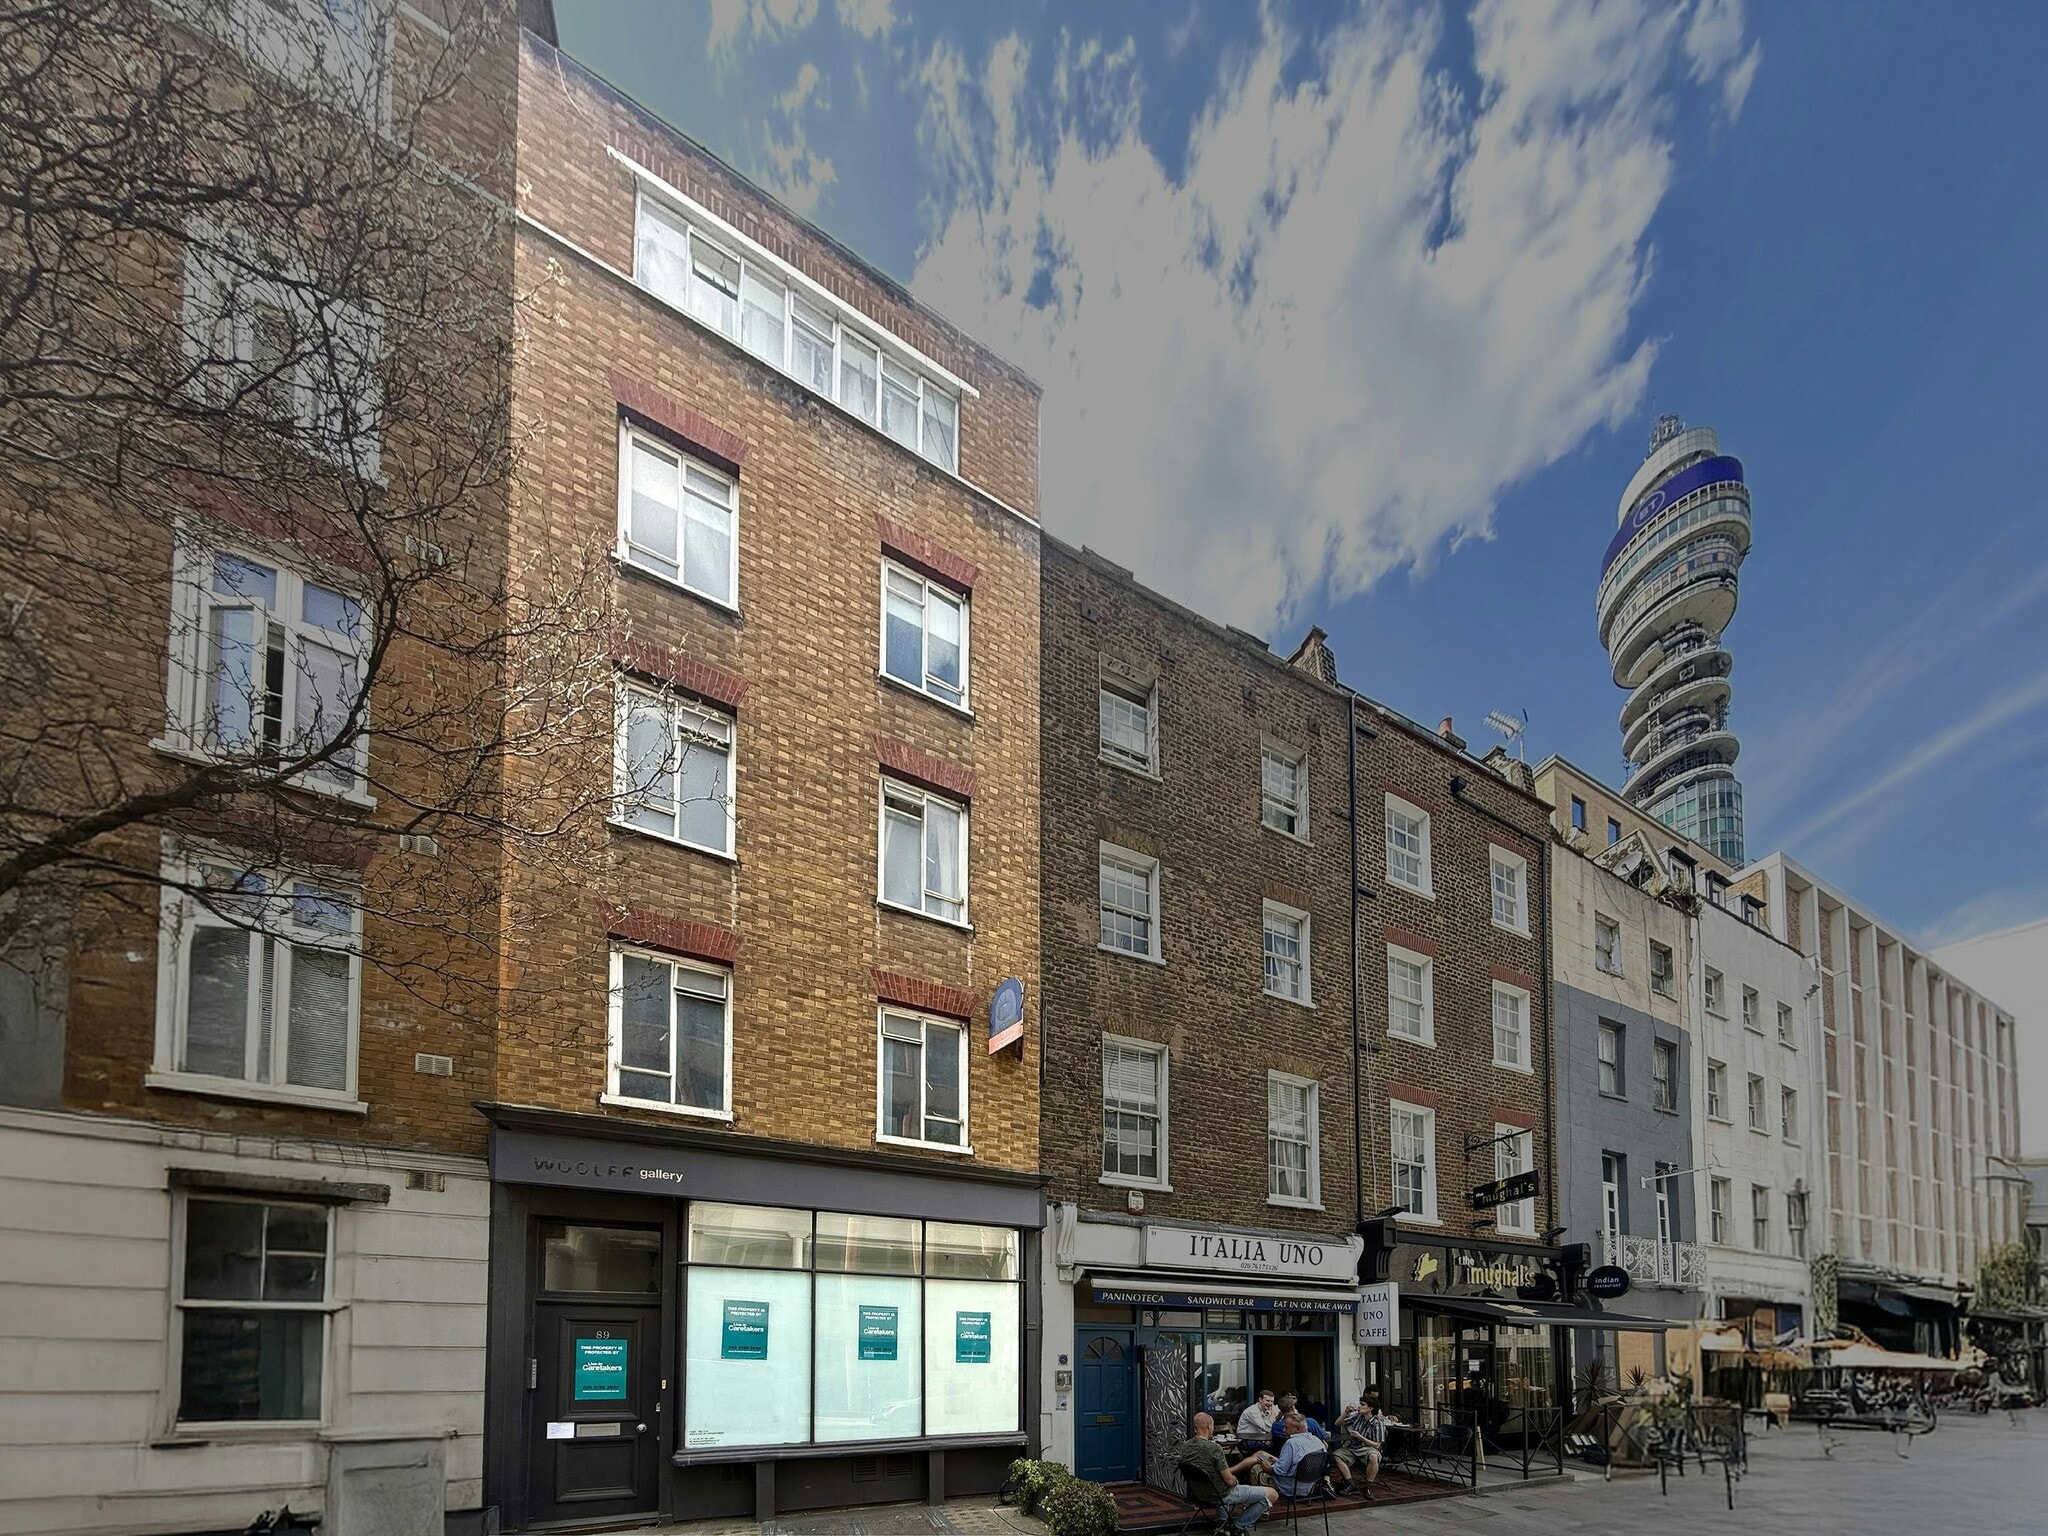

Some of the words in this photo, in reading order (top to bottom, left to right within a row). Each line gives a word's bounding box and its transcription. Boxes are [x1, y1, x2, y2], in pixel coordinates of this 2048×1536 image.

[1640, 497, 1658, 520] BT
[534, 1156, 634, 1178] WOOLFF
[639, 1168, 684, 1183] gallery
[1482, 1182, 1535, 1203] mughal's
[1189, 1235, 1267, 1262] ITALIA
[1279, 1243, 1323, 1266] UNO
[1467, 1263, 1536, 1292] mughal's
[1101, 1291, 1165, 1303] PANINOTECA
[1187, 1295, 1236, 1306] SANDWICH
[1238, 1298, 1254, 1307] BAR
[1273, 1300, 1287, 1308] EAT
[1289, 1301, 1299, 1309] IN
[1300, 1301, 1312, 1309] OR
[1313, 1302, 1331, 1310] TAKE
[1331, 1302, 1353, 1311] AWAY
[1360, 1293, 1388, 1303] TALIA
[1363, 1310, 1384, 1320] UNO
[596, 1330, 610, 1339] 89
[728, 1324, 765, 1333] Caretakers
[1359, 1328, 1388, 1337] CAFFE
